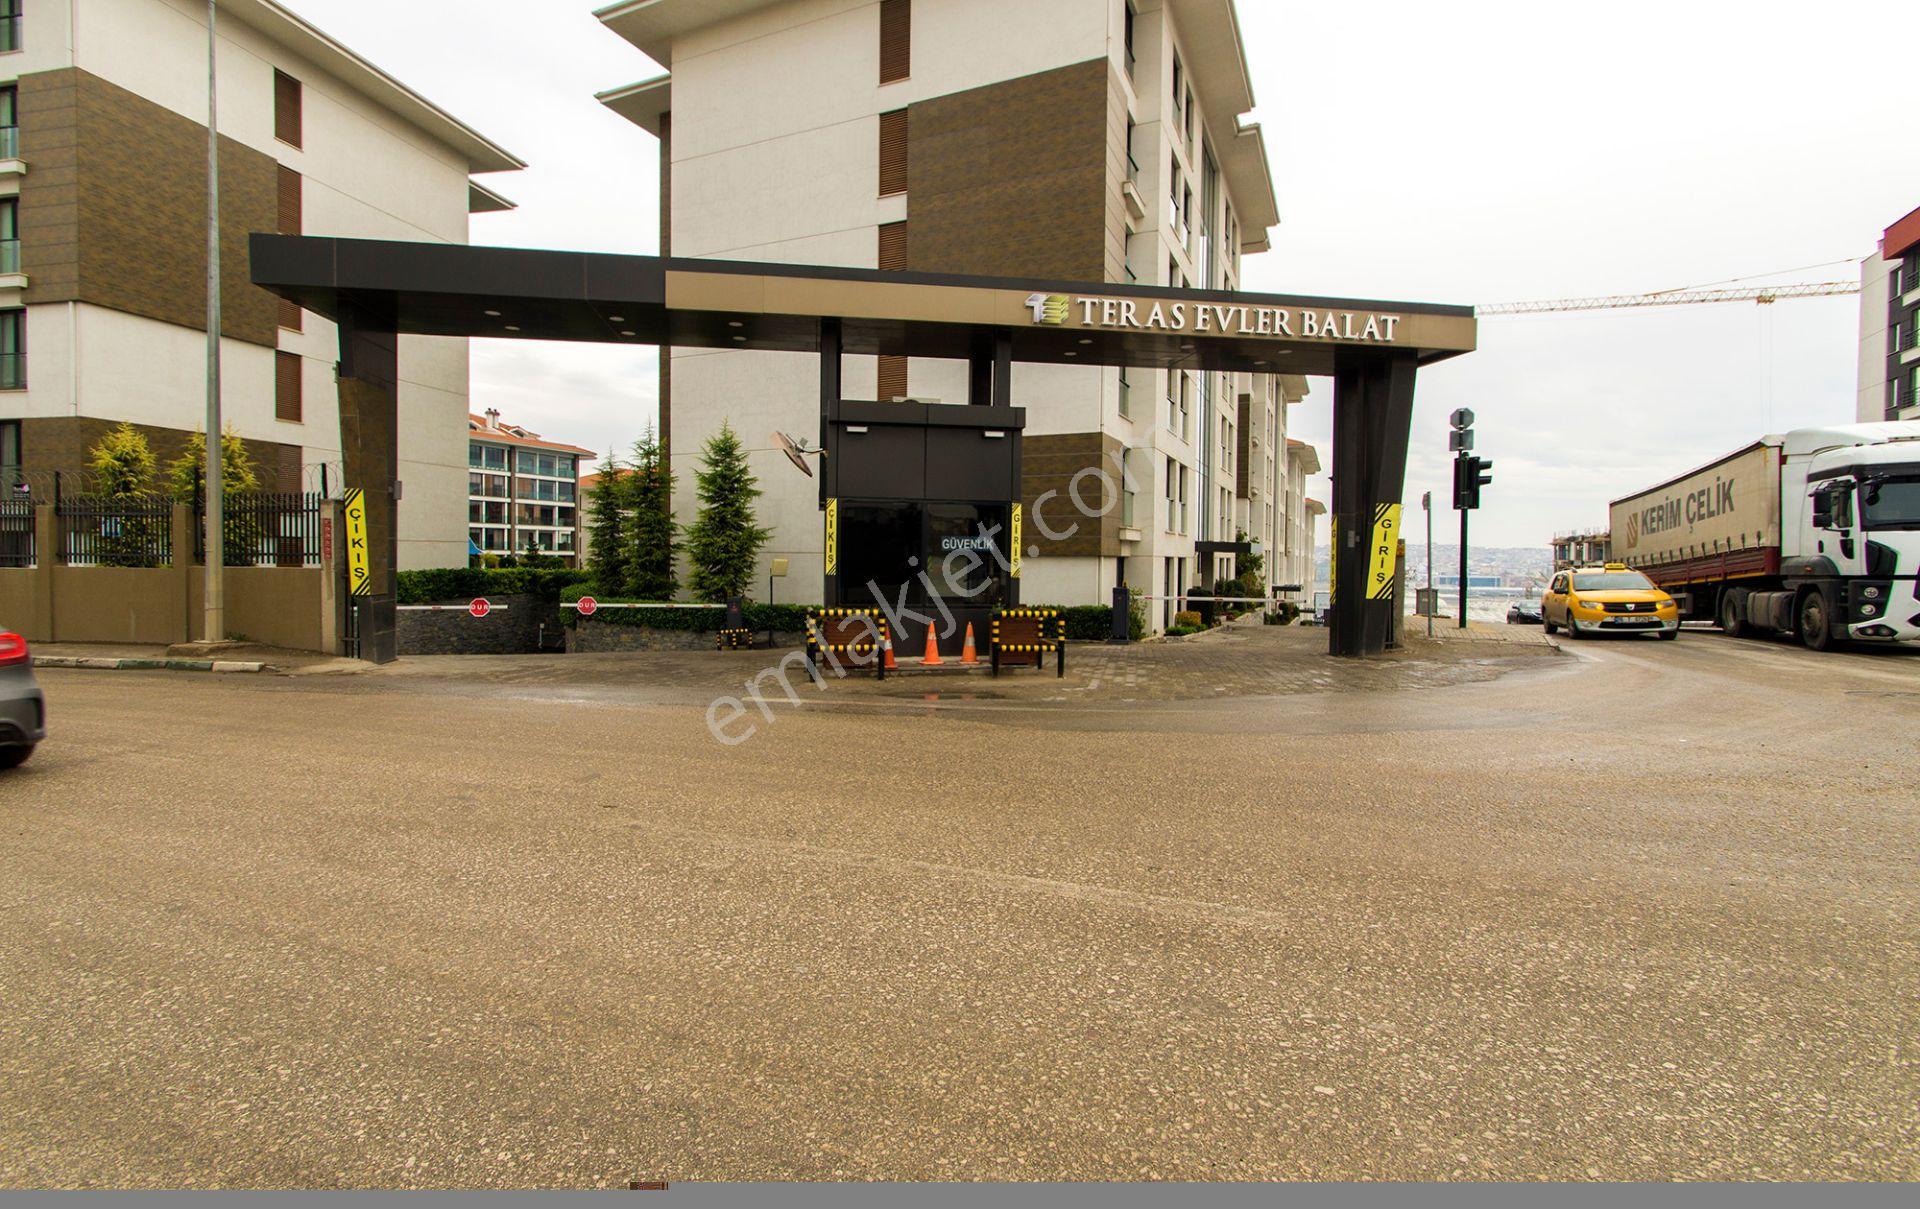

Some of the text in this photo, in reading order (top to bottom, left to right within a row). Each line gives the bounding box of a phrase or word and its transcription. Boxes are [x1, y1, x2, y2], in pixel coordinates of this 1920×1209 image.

[1077, 297, 1186, 330] TERAS
[1193, 304, 1294, 336] EVLER
[1300, 310, 1400, 341] BALAT
[1641, 476, 1735, 536] KERİM ÇELİK
[942, 536, 994, 550] GÜVENLİK
